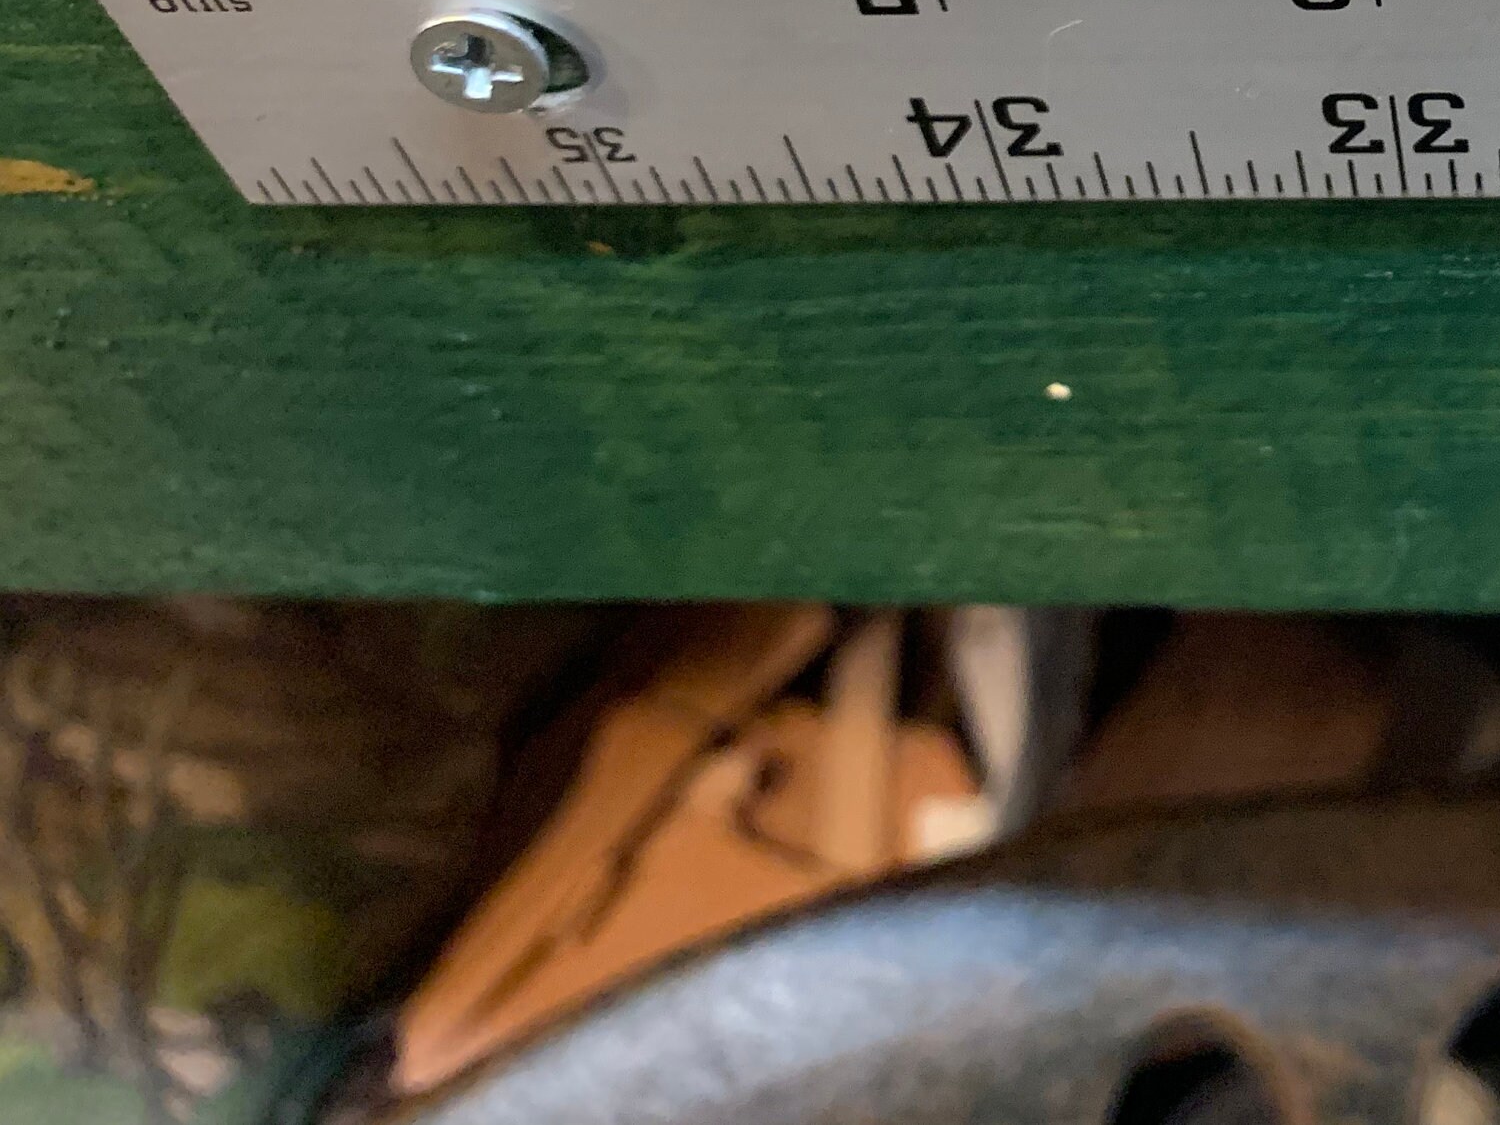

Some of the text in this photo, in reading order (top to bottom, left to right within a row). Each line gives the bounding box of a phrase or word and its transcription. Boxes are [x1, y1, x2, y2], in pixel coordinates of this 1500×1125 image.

[545, 126, 637, 164] 35
[905, 95, 1065, 159] 34
[1320, 91, 1471, 155] 33
